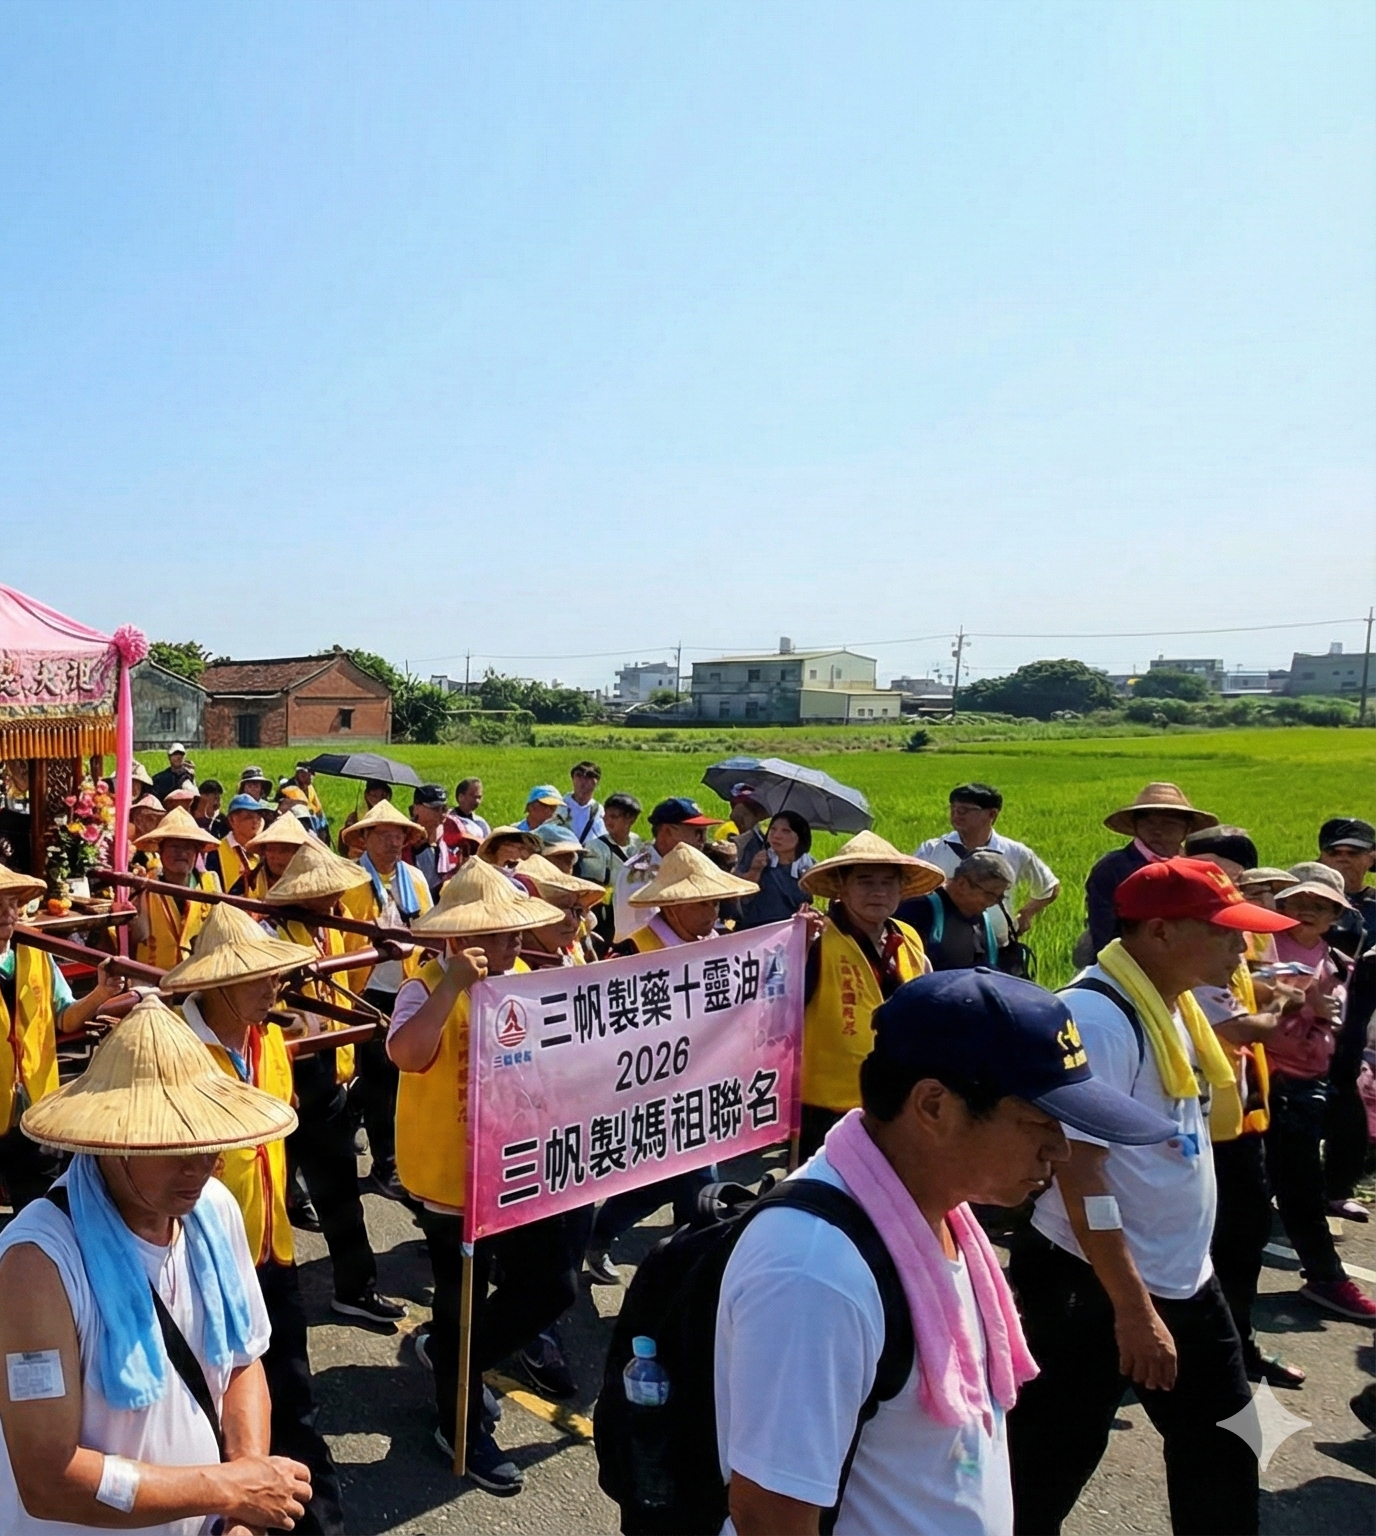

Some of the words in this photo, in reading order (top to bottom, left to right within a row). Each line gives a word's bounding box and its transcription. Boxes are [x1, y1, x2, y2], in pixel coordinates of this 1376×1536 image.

[539, 950, 761, 1048] 三帆製藥十靈油
[615, 1035, 690, 1092] 2026
[498, 1069, 779, 1207] 三帆製媽祖聯名
